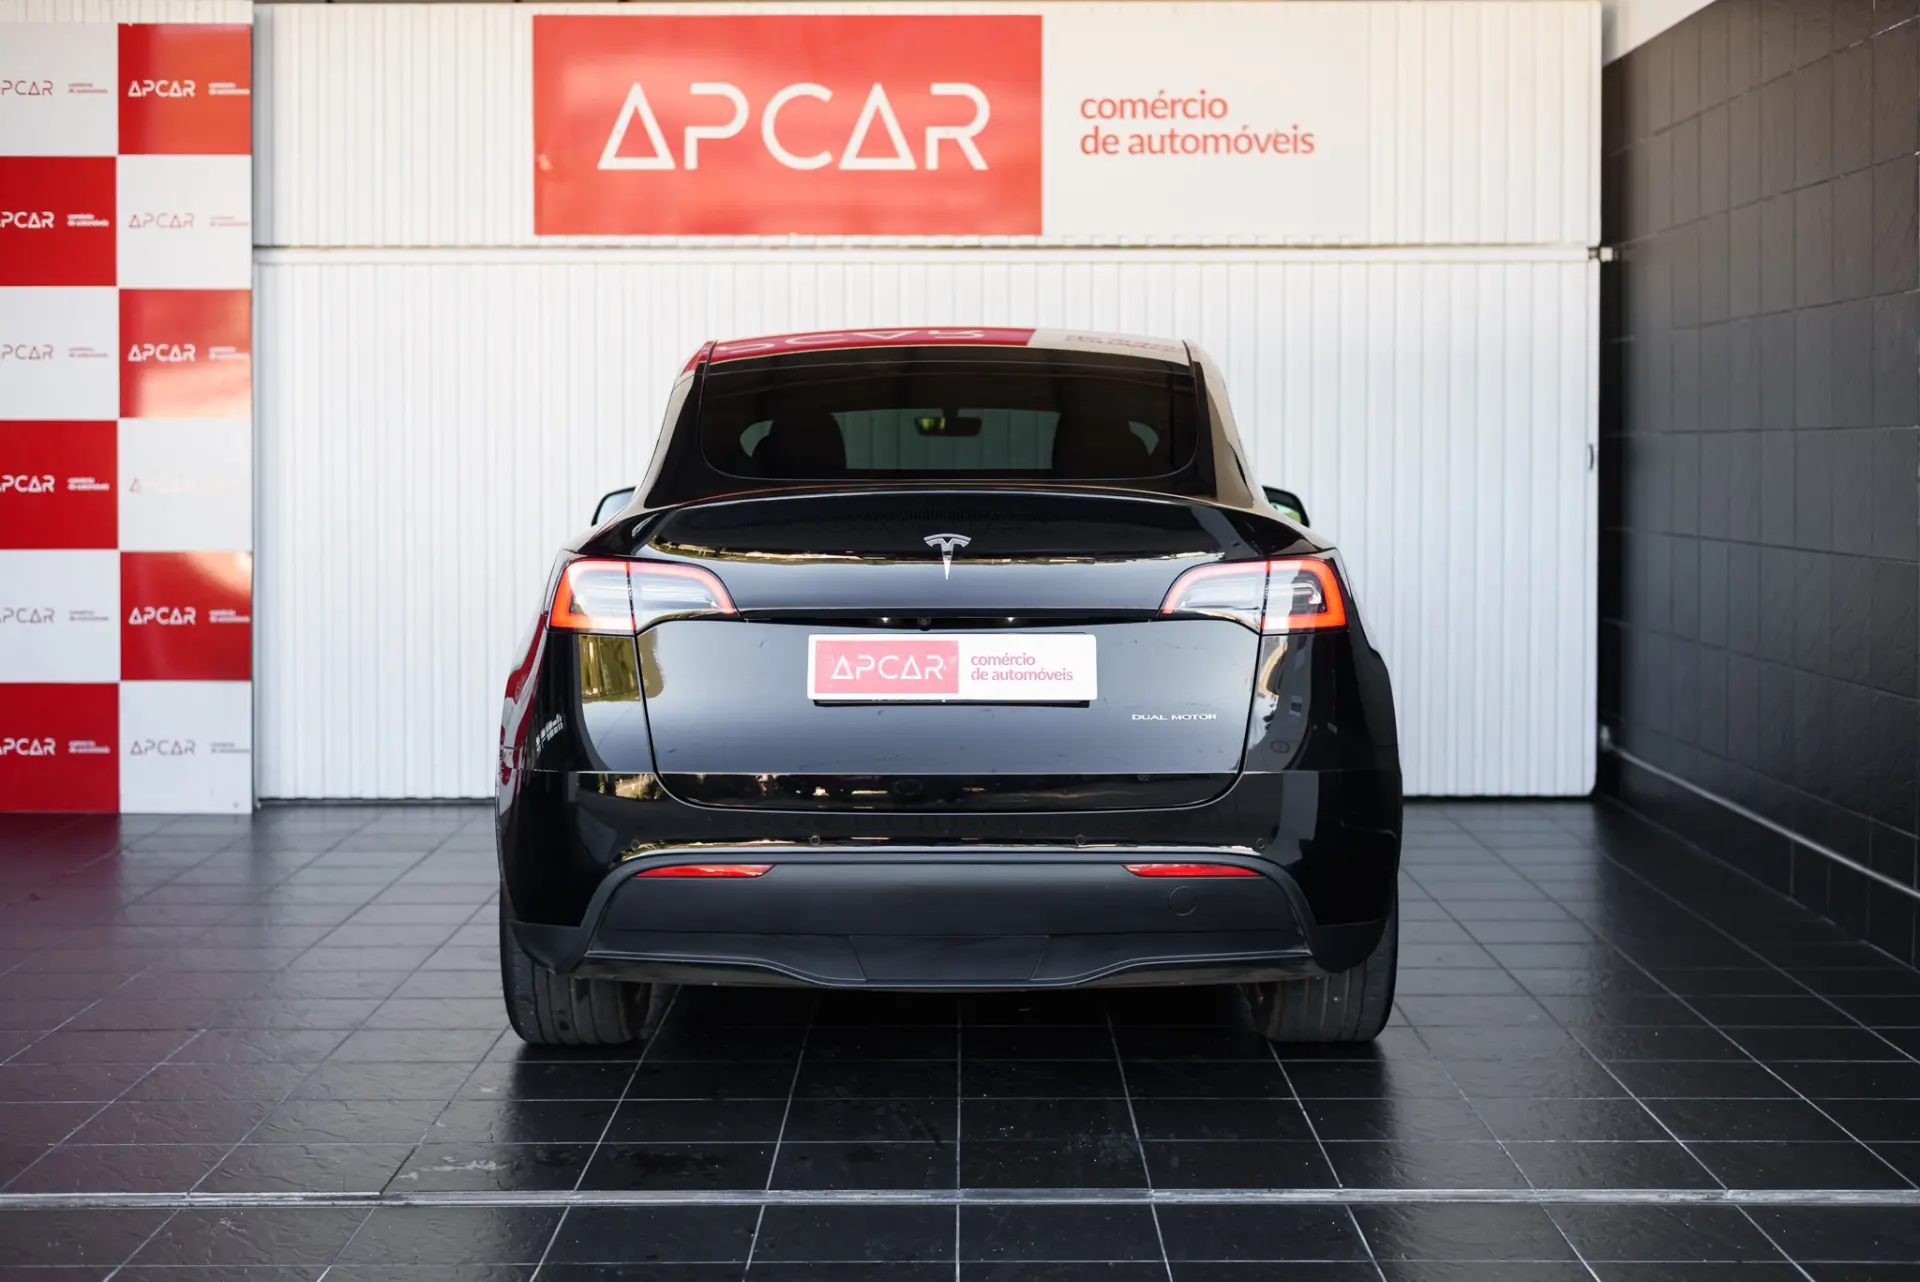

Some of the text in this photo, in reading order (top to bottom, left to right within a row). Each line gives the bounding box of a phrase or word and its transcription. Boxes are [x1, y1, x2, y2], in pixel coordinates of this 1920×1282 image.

[128, 80, 196, 98] APCAR
[1080, 89, 1228, 119] comércio
[598, 83, 990, 171] APCAR
[1080, 124, 1314, 155] de automóveis
[0, 211, 54, 229] PCAR
[128, 212, 195, 229] APCAR
[128, 344, 196, 362] APCAR
[0, 474, 55, 492] PCAR
[0, 608, 55, 624] PCAR
[128, 607, 196, 626] APCAR
[830, 654, 945, 680] APCAR
[970, 653, 1036, 666] comércio
[970, 667, 1074, 681] de automóveis
[1131, 713, 1217, 721] DUAL MOTOR
[0, 738, 56, 756] PCAR
[130, 739, 196, 756] APCAR
